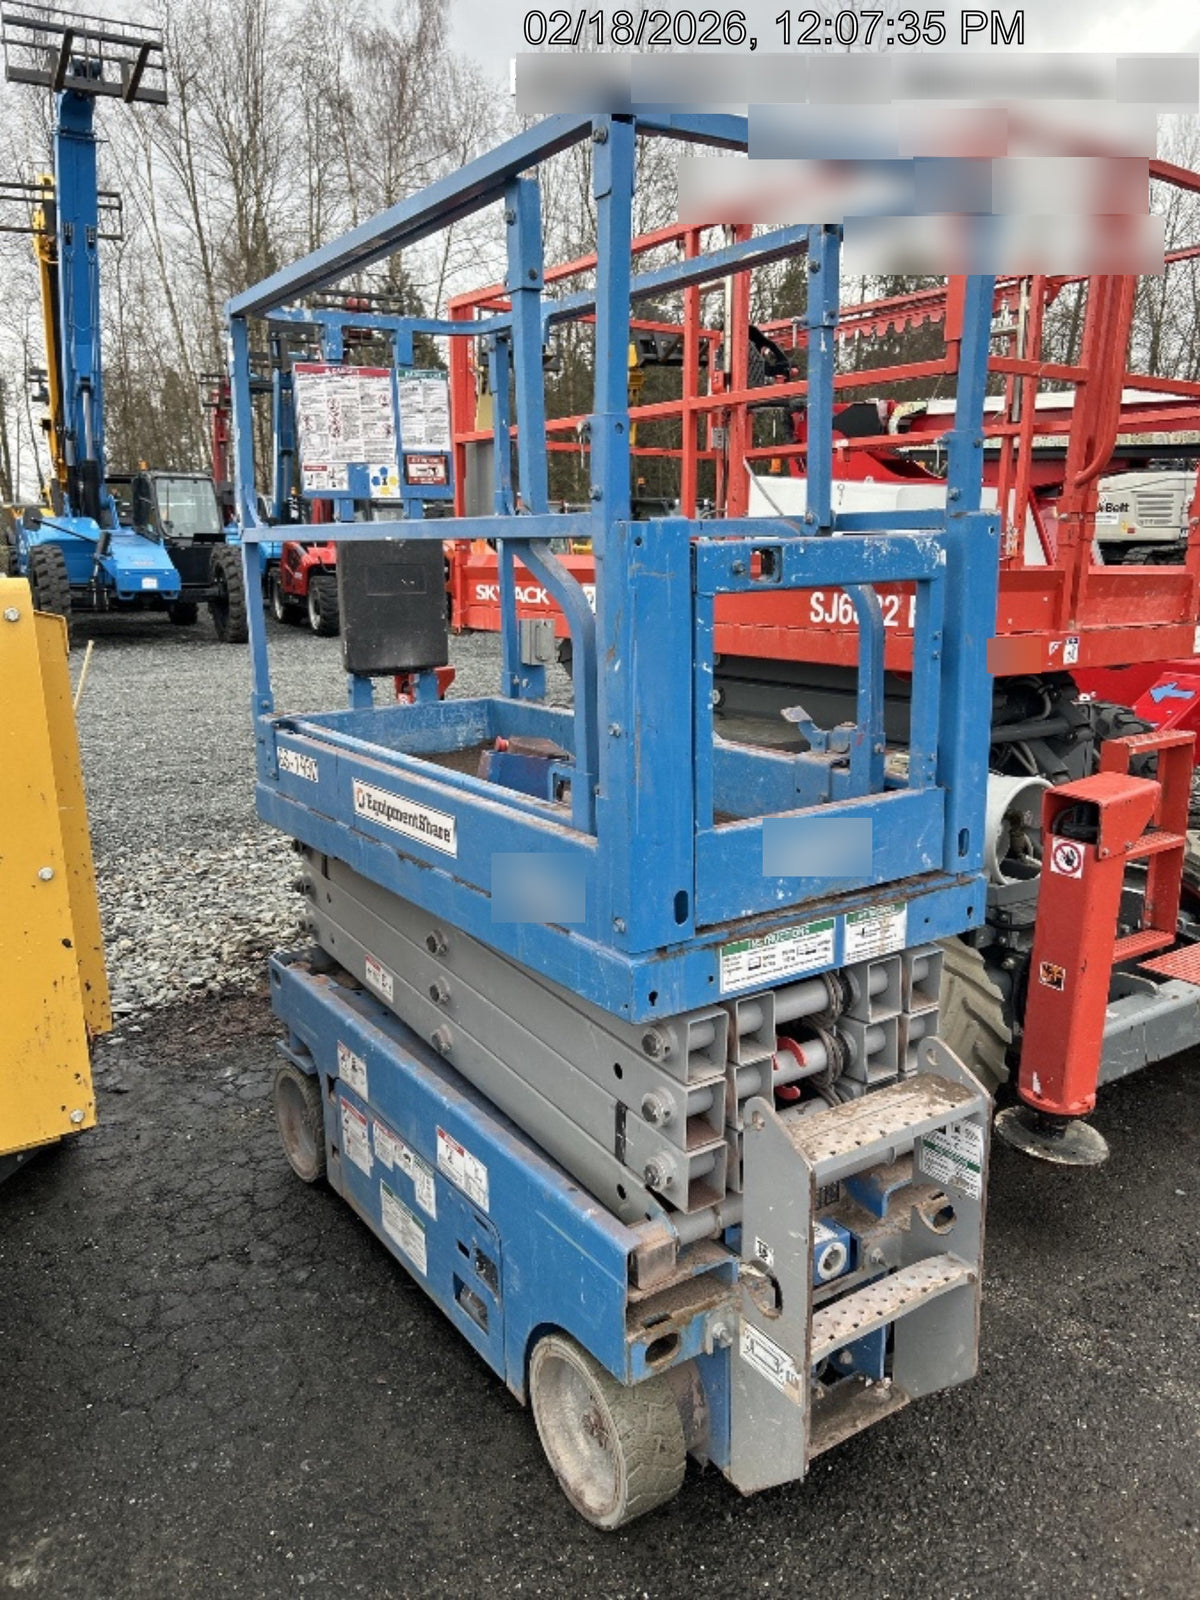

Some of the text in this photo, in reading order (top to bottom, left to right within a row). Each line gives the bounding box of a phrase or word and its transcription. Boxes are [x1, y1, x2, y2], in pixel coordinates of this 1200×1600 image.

[475, 584, 550, 605] SKACK
[809, 591, 899, 627] SJ62
[366, 792, 451, 843] EquipmentShare
